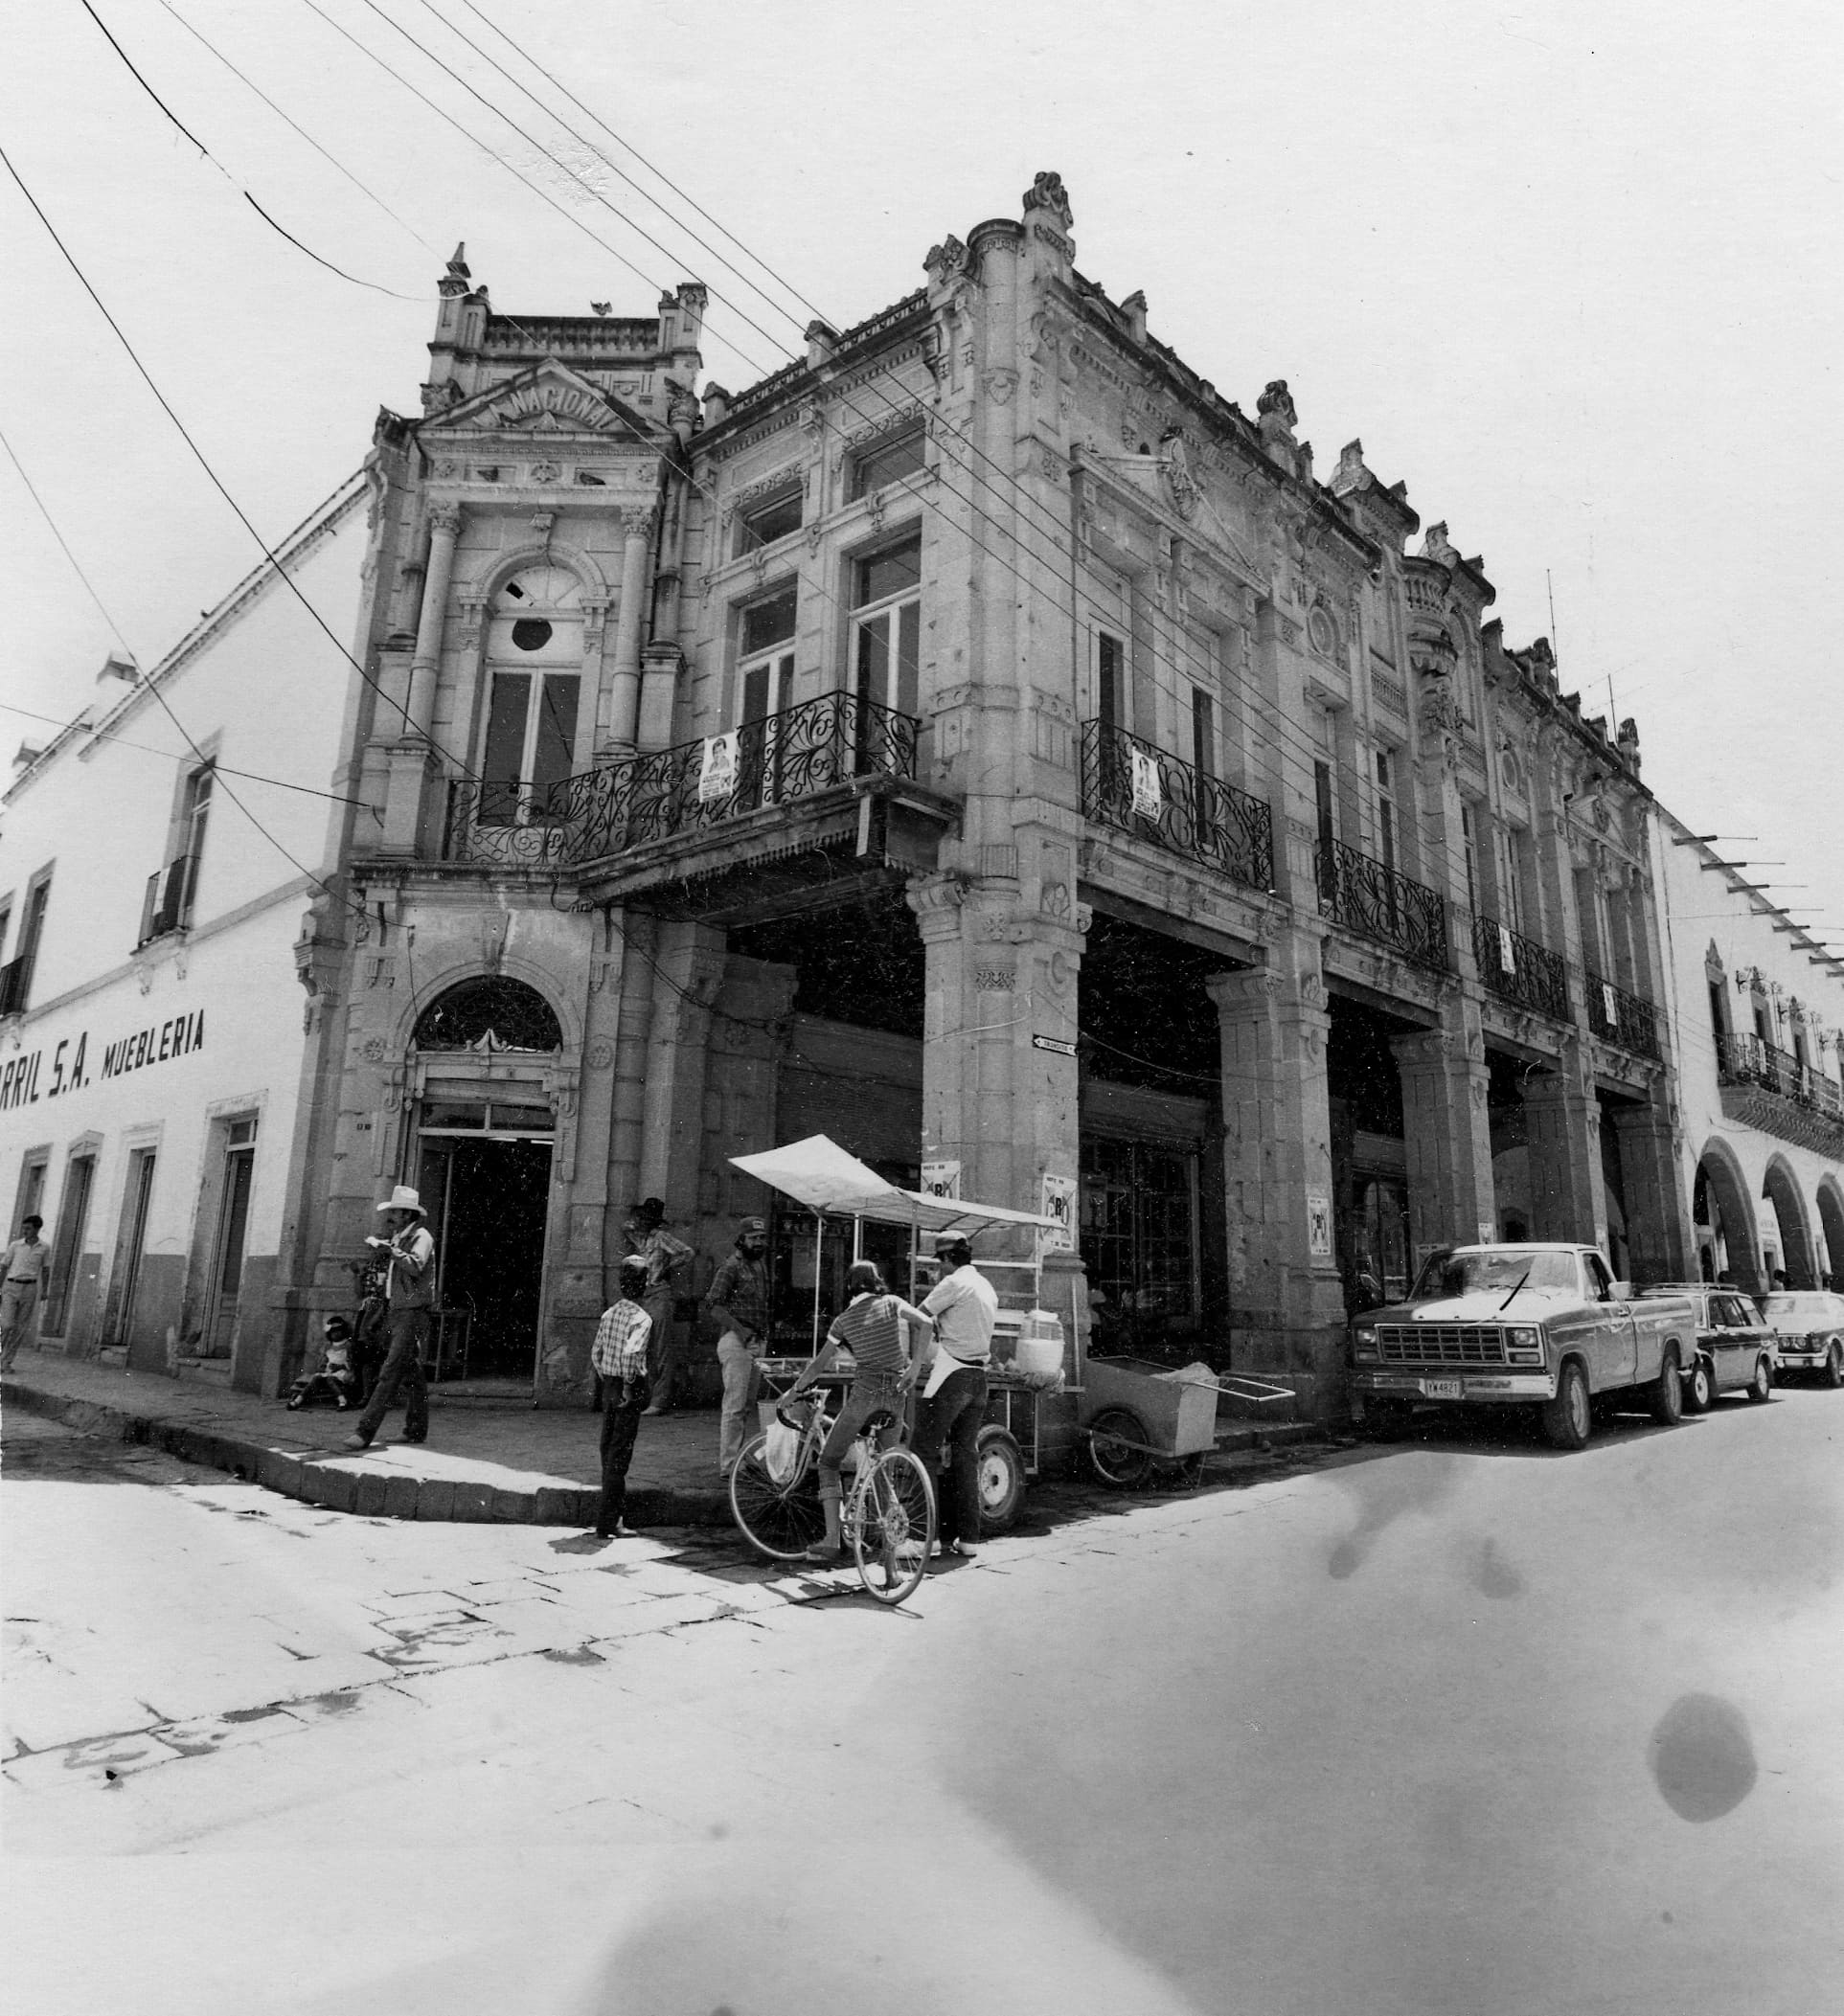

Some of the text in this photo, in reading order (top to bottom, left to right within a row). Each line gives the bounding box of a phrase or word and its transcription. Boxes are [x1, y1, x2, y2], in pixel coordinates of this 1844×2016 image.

[509, 385, 616, 429] NACIONAL
[0, 1008, 204, 1111] RRIL S.A. MUEBLERIA
